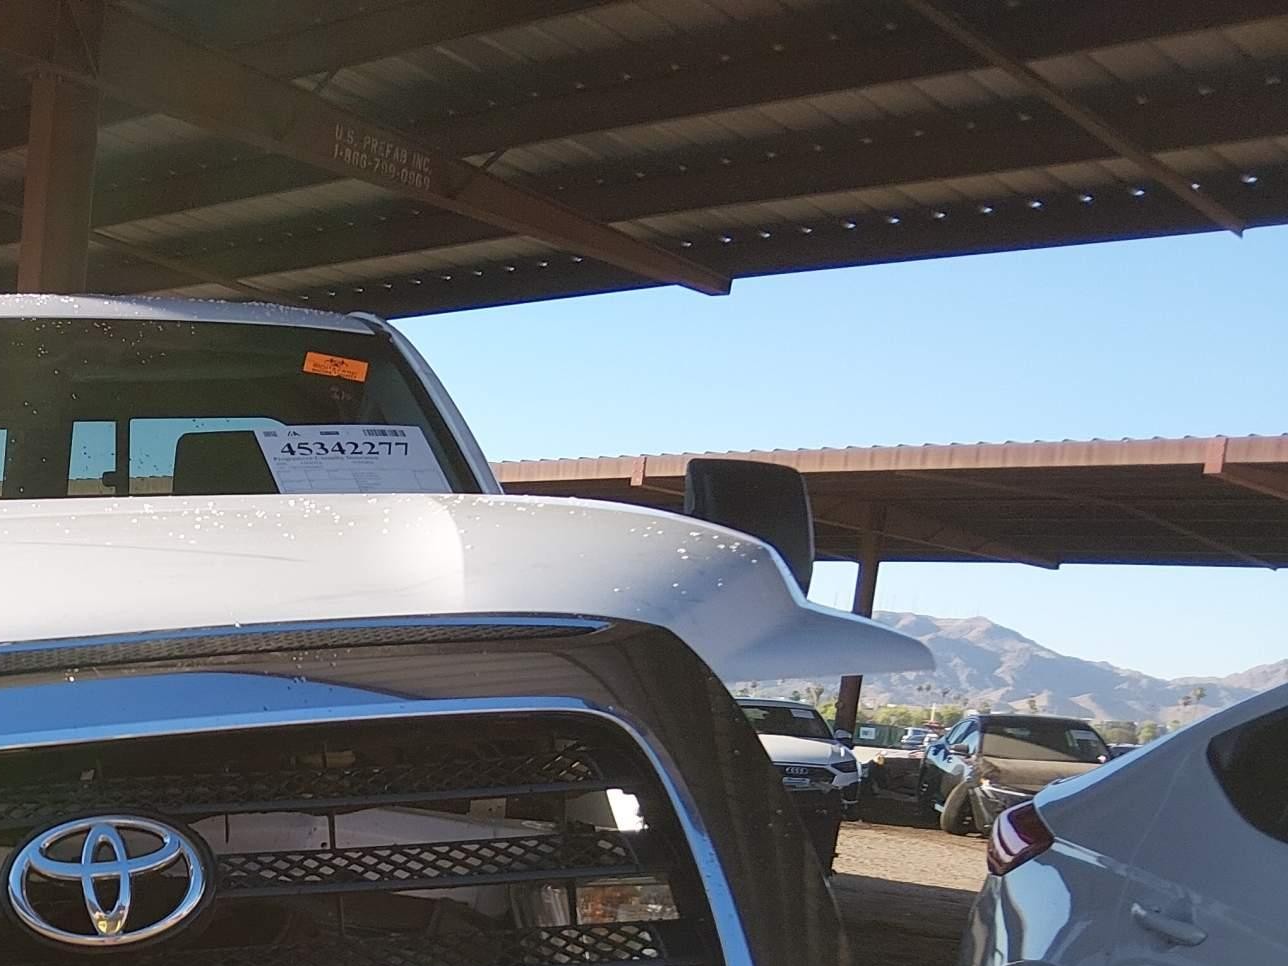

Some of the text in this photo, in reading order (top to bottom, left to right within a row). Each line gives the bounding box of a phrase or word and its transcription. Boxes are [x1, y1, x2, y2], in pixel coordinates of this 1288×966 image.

[333, 143, 431, 191] 1-866-799-0969
[335, 123, 432, 175] U.S. PREFAB INC.
[280, 441, 409, 456] 45342277
